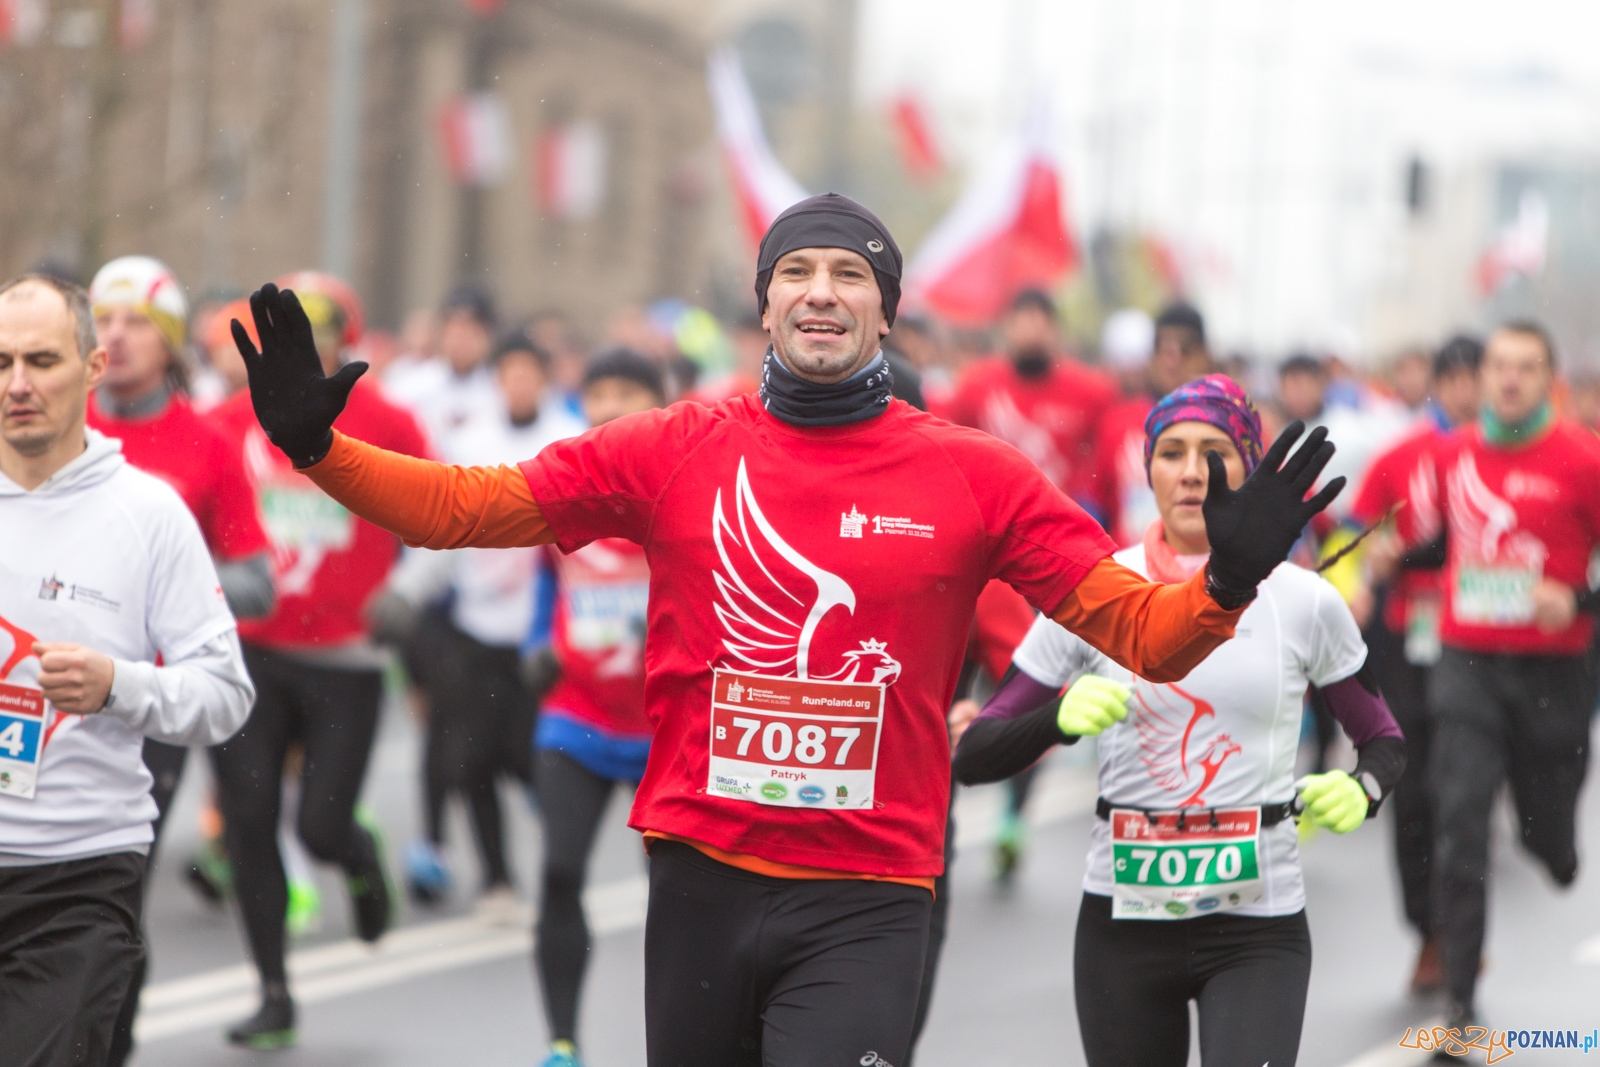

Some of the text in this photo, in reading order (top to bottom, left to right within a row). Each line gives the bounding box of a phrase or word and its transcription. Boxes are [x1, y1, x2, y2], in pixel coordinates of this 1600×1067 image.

[872, 516, 883, 534] 1
[68, 583, 76, 601] 1
[746, 687, 754, 701] 1
[802, 696, 871, 710] RunPoland.org
[715, 716, 861, 765] B 7087
[716, 776, 738, 787] GRUPA
[771, 769, 807, 781] Patryk
[715, 783, 743, 795] LUXMED
[1115, 845, 1243, 885] C 7070
